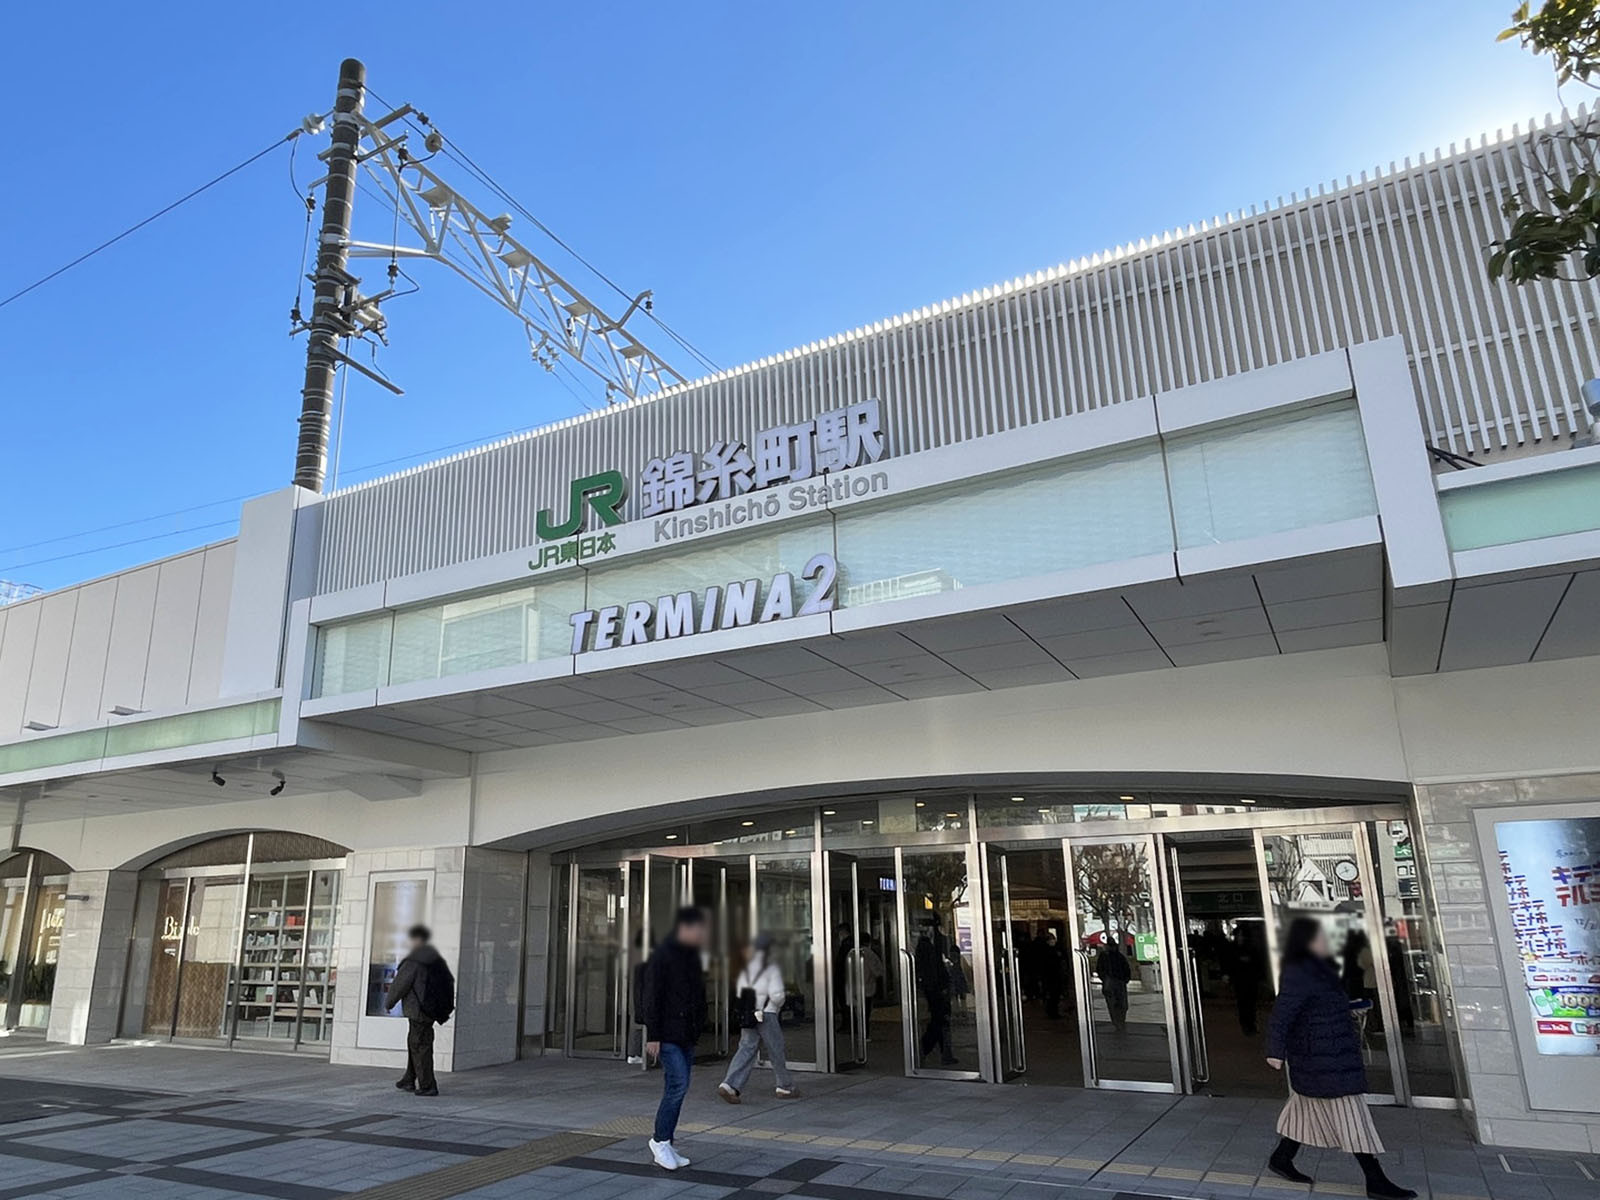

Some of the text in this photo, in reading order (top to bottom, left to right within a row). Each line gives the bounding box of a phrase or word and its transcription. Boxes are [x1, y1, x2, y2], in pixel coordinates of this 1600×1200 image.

[642, 399, 885, 518] 錦糸町駅
[536, 470, 628, 542] JR
[654, 471, 889, 543] Kinshichō Station
[528, 532, 616, 570] JR東日本
